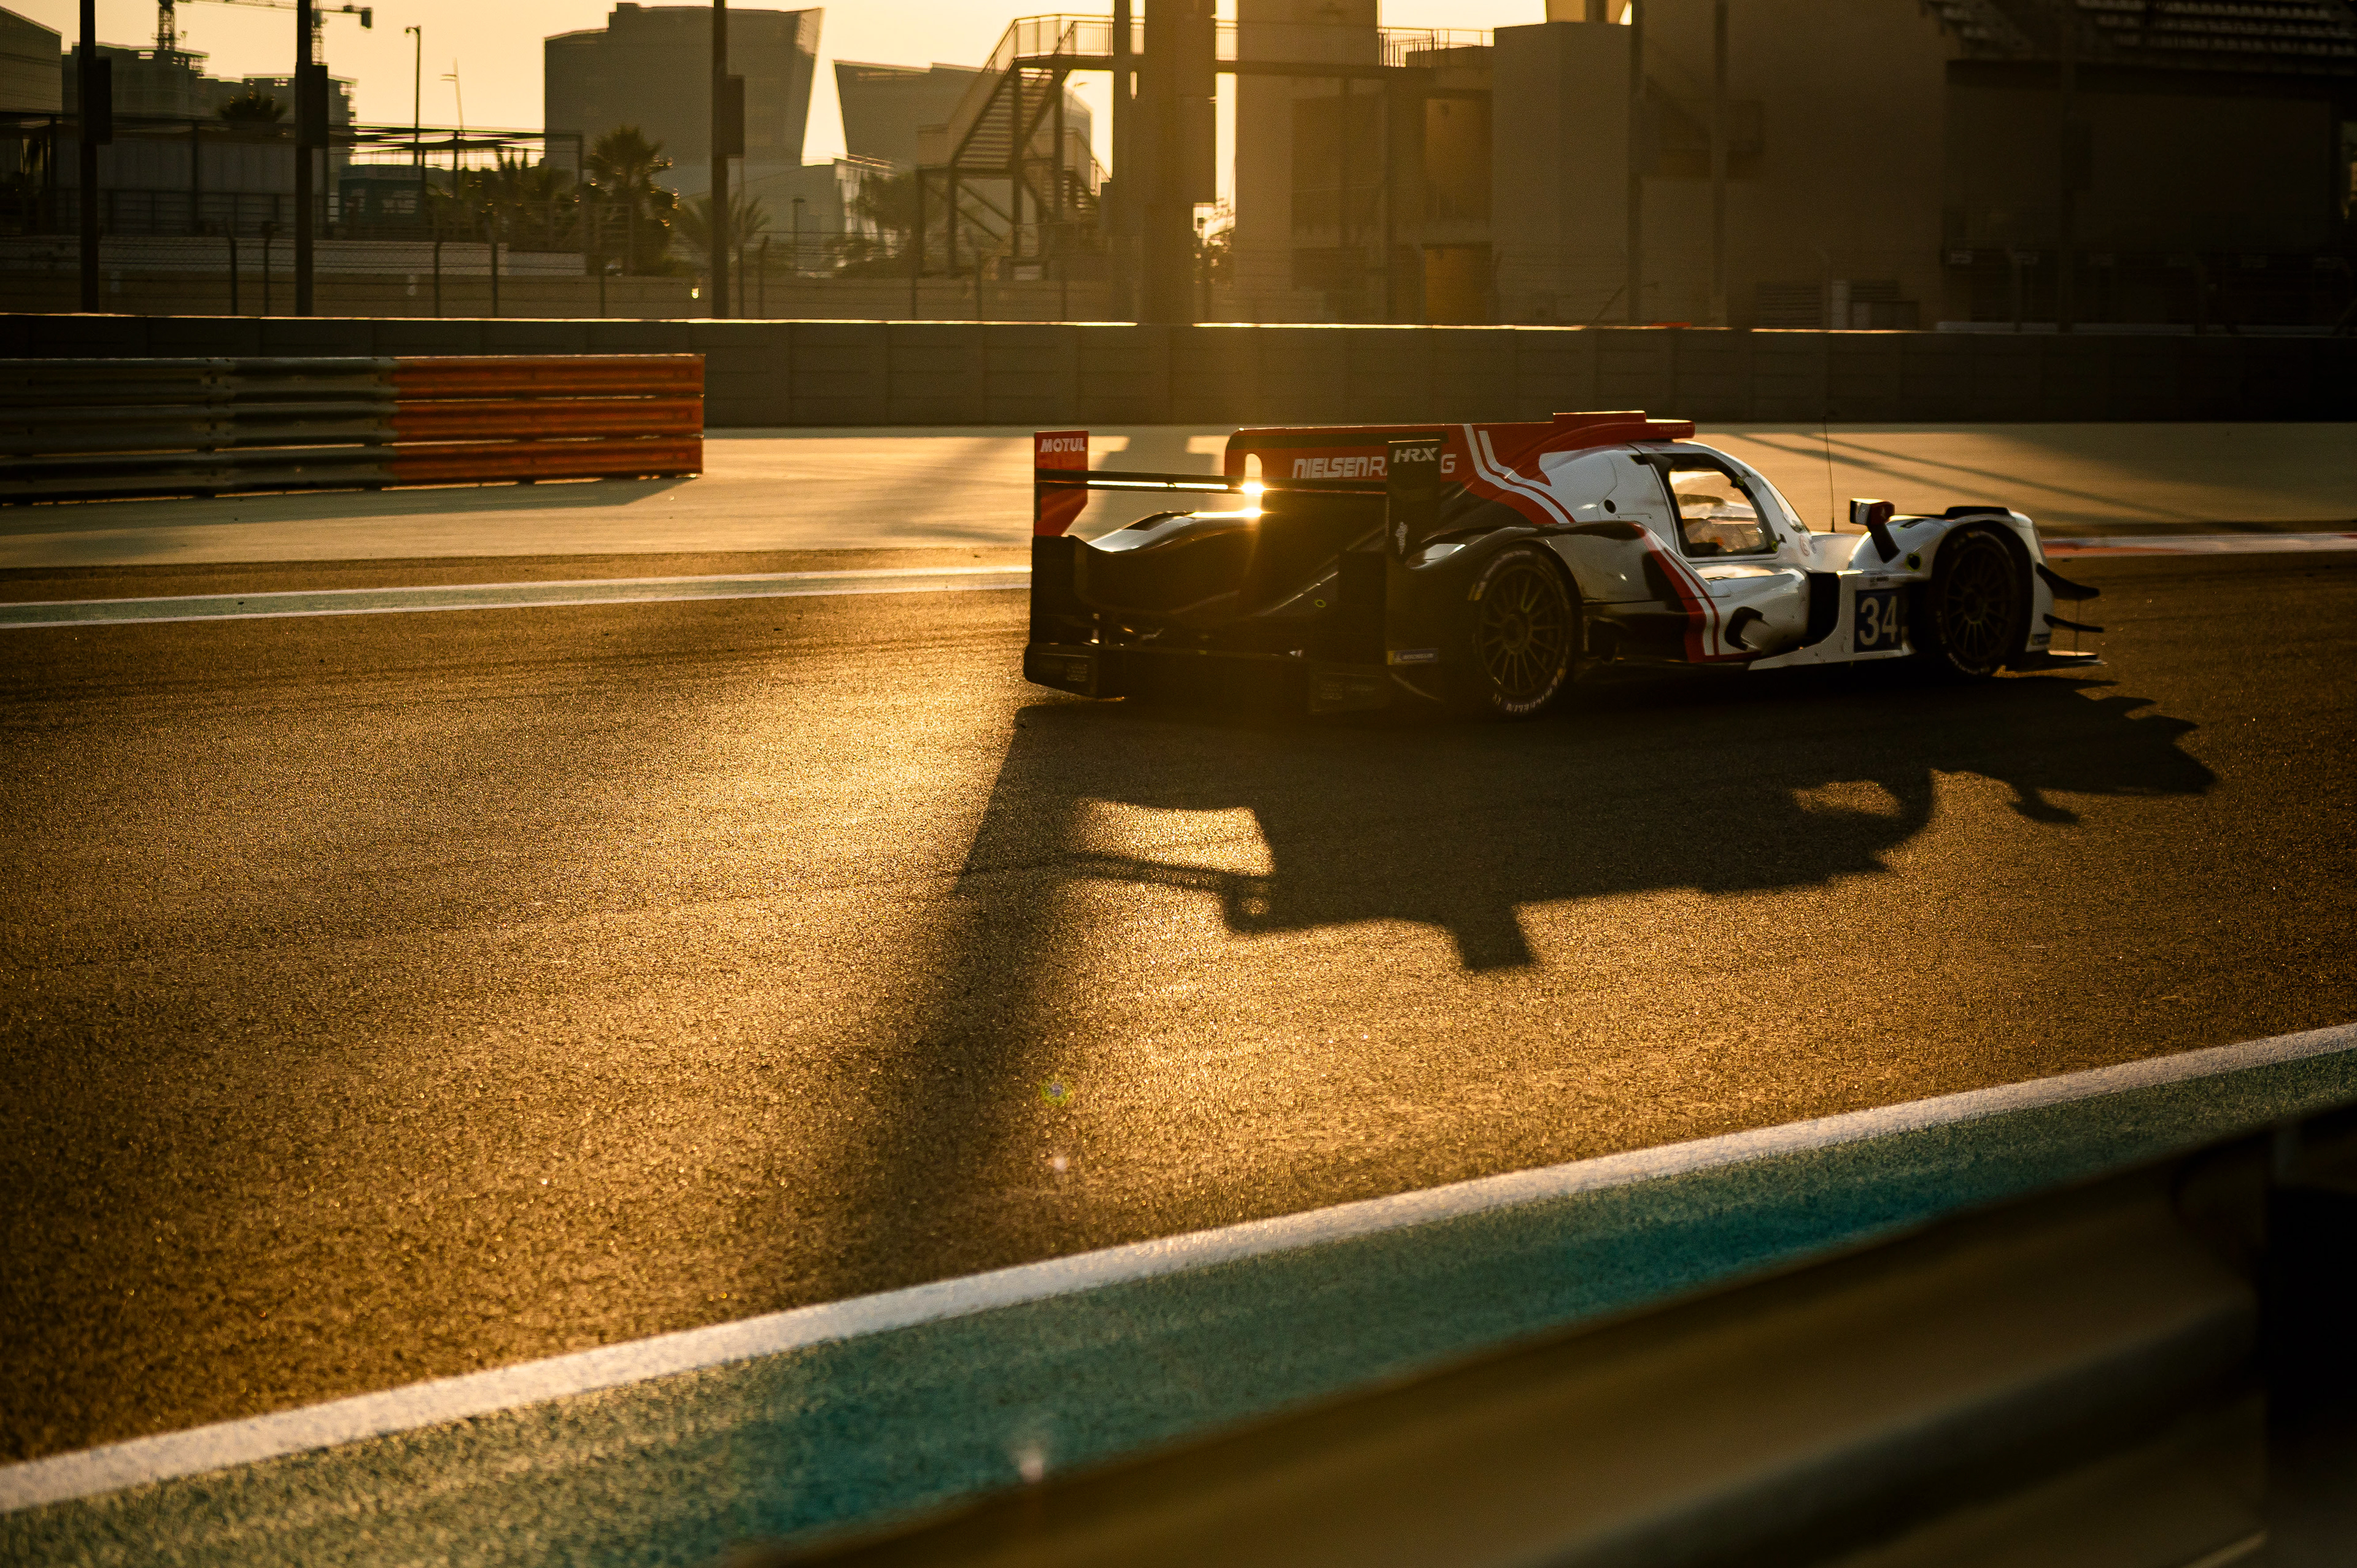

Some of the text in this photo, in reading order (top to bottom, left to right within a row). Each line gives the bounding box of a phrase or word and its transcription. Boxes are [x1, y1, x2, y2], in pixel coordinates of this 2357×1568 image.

[1040, 438, 1085, 453] MOTUL
[1393, 447, 1439, 463] HRX
[1859, 595, 1898, 646] 34
